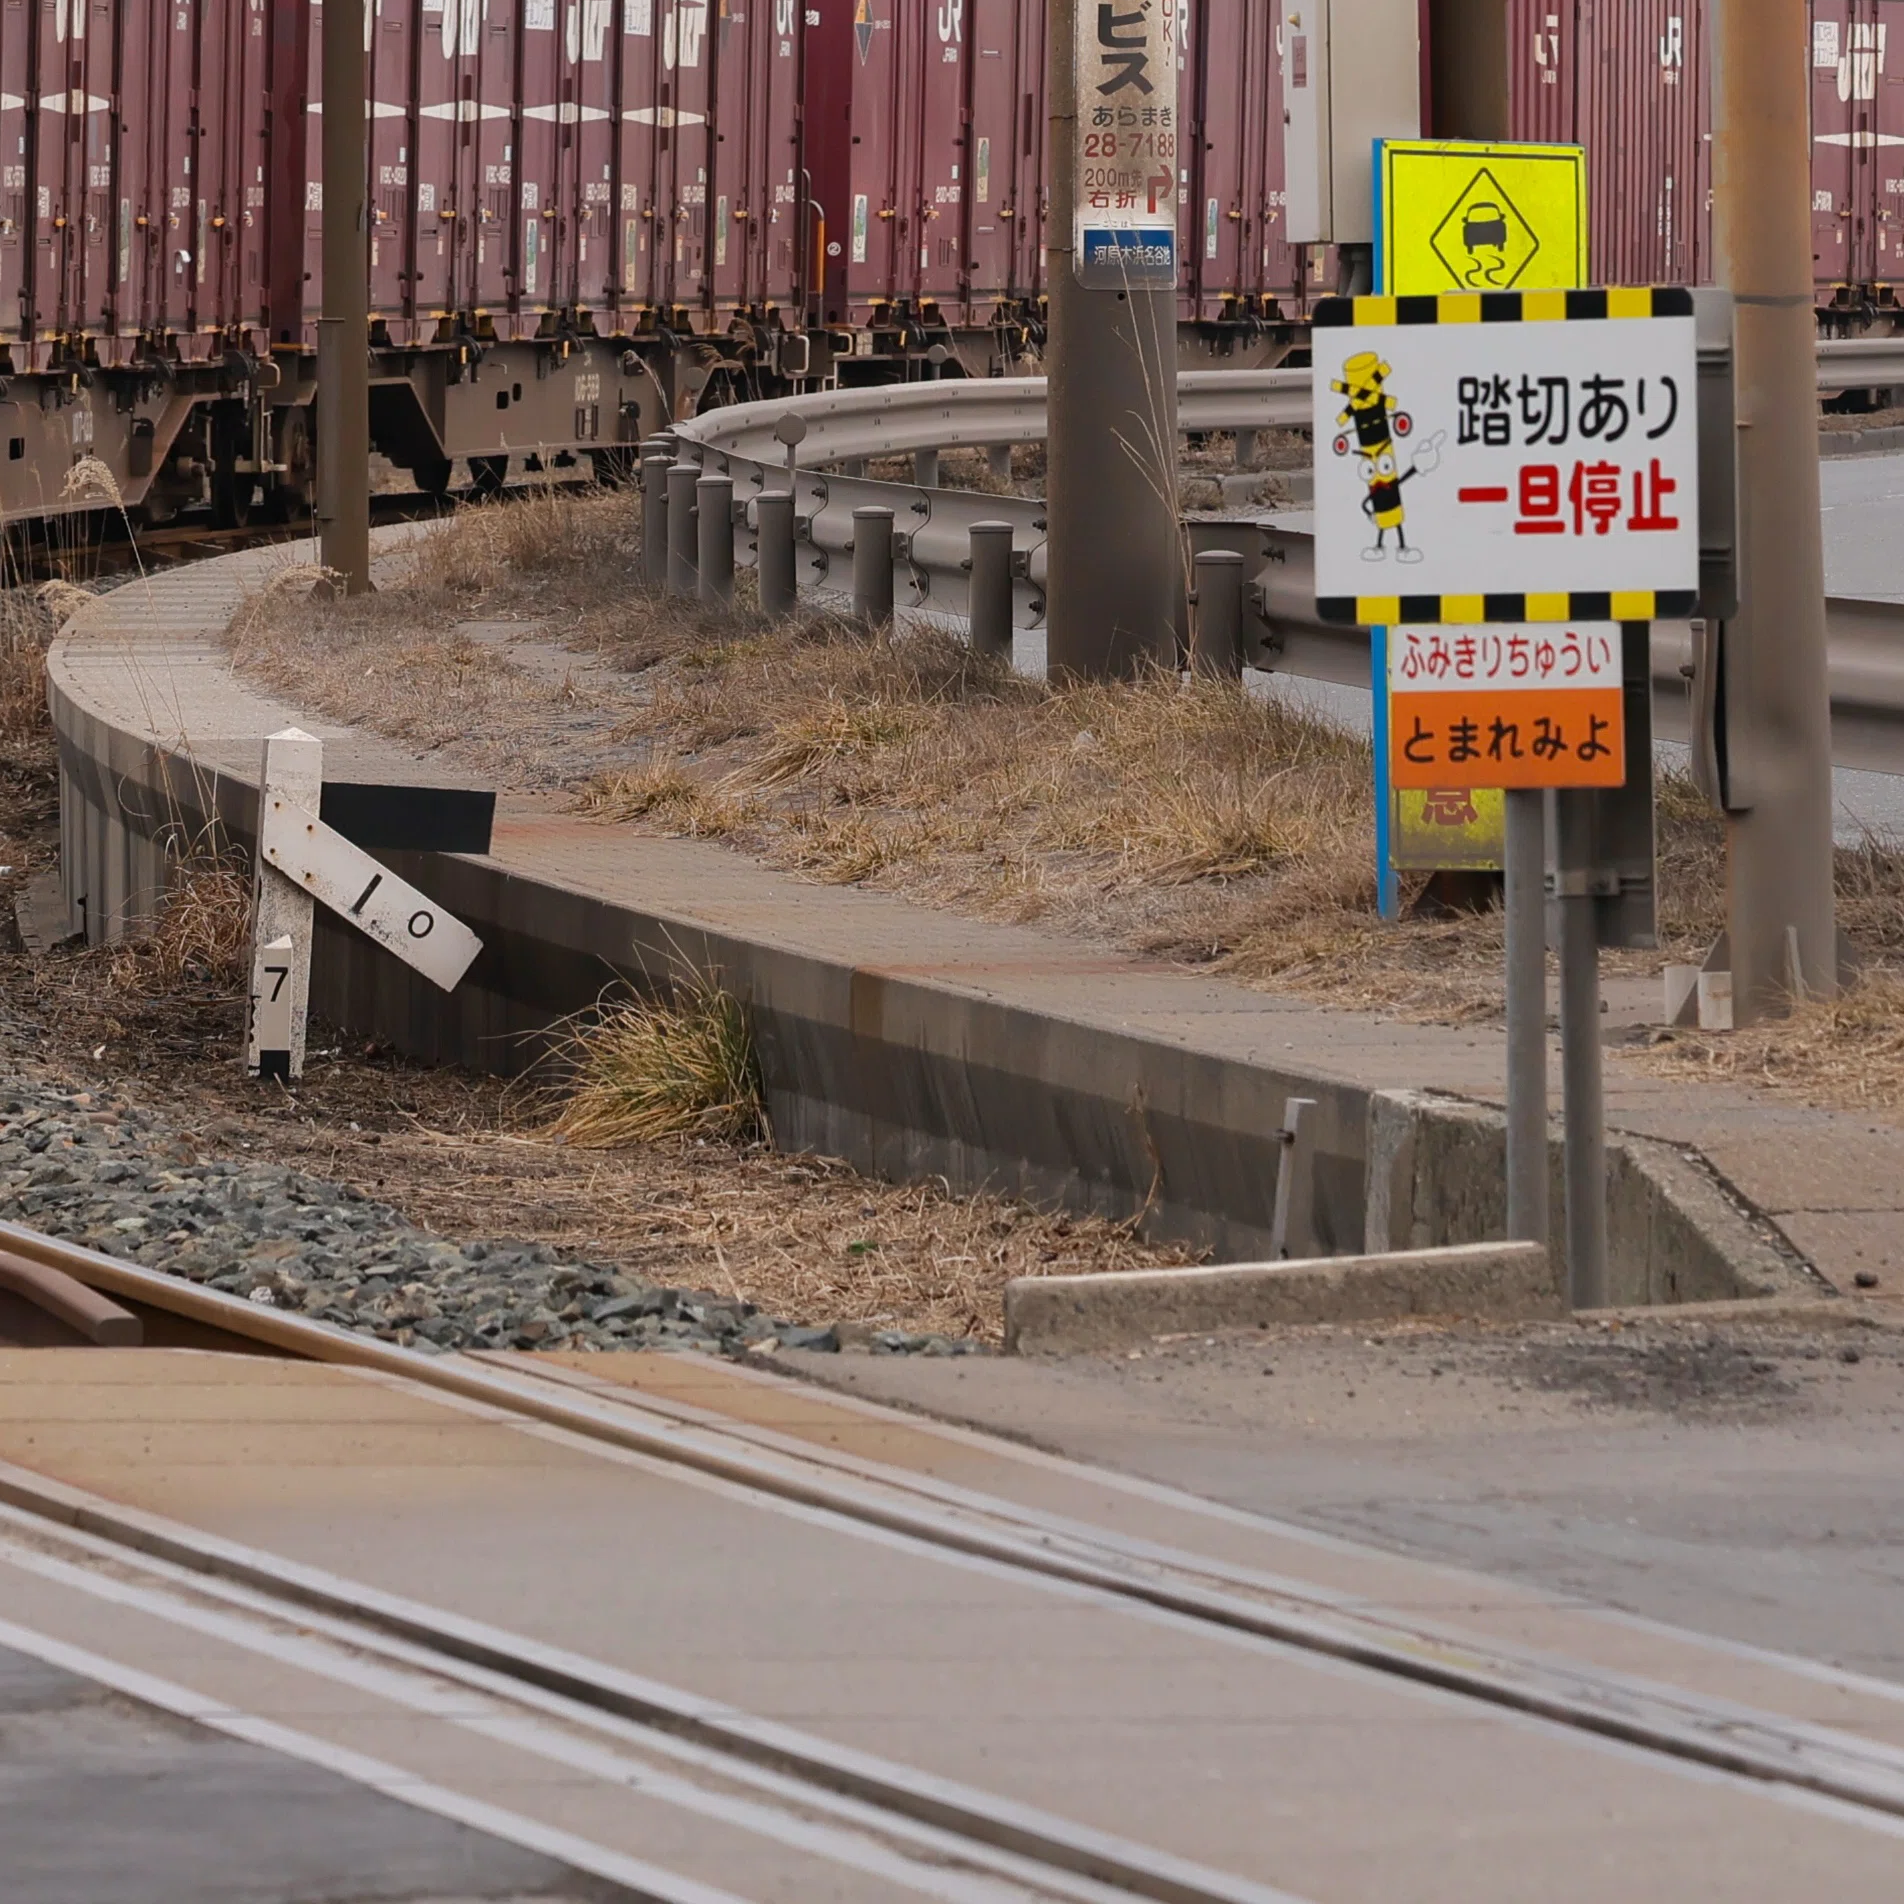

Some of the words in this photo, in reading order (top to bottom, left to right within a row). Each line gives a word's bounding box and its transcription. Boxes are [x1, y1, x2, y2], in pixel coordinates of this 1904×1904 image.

[1659, 16, 1682, 68] JR
[1092, 106, 1173, 128] あらまき
[1084, 132, 1176, 159] 28-7188
[1084, 167, 1143, 188] 200m先
[1088, 189, 1138, 210] 右折
[1457, 373, 1679, 447] 踏切あり
[1457, 457, 1679, 536] 一旦停止
[1400, 632, 1611, 679] ふみきりちゅうい
[1403, 714, 1612, 764] とまれみよ
[264, 966, 289, 1002] 7
